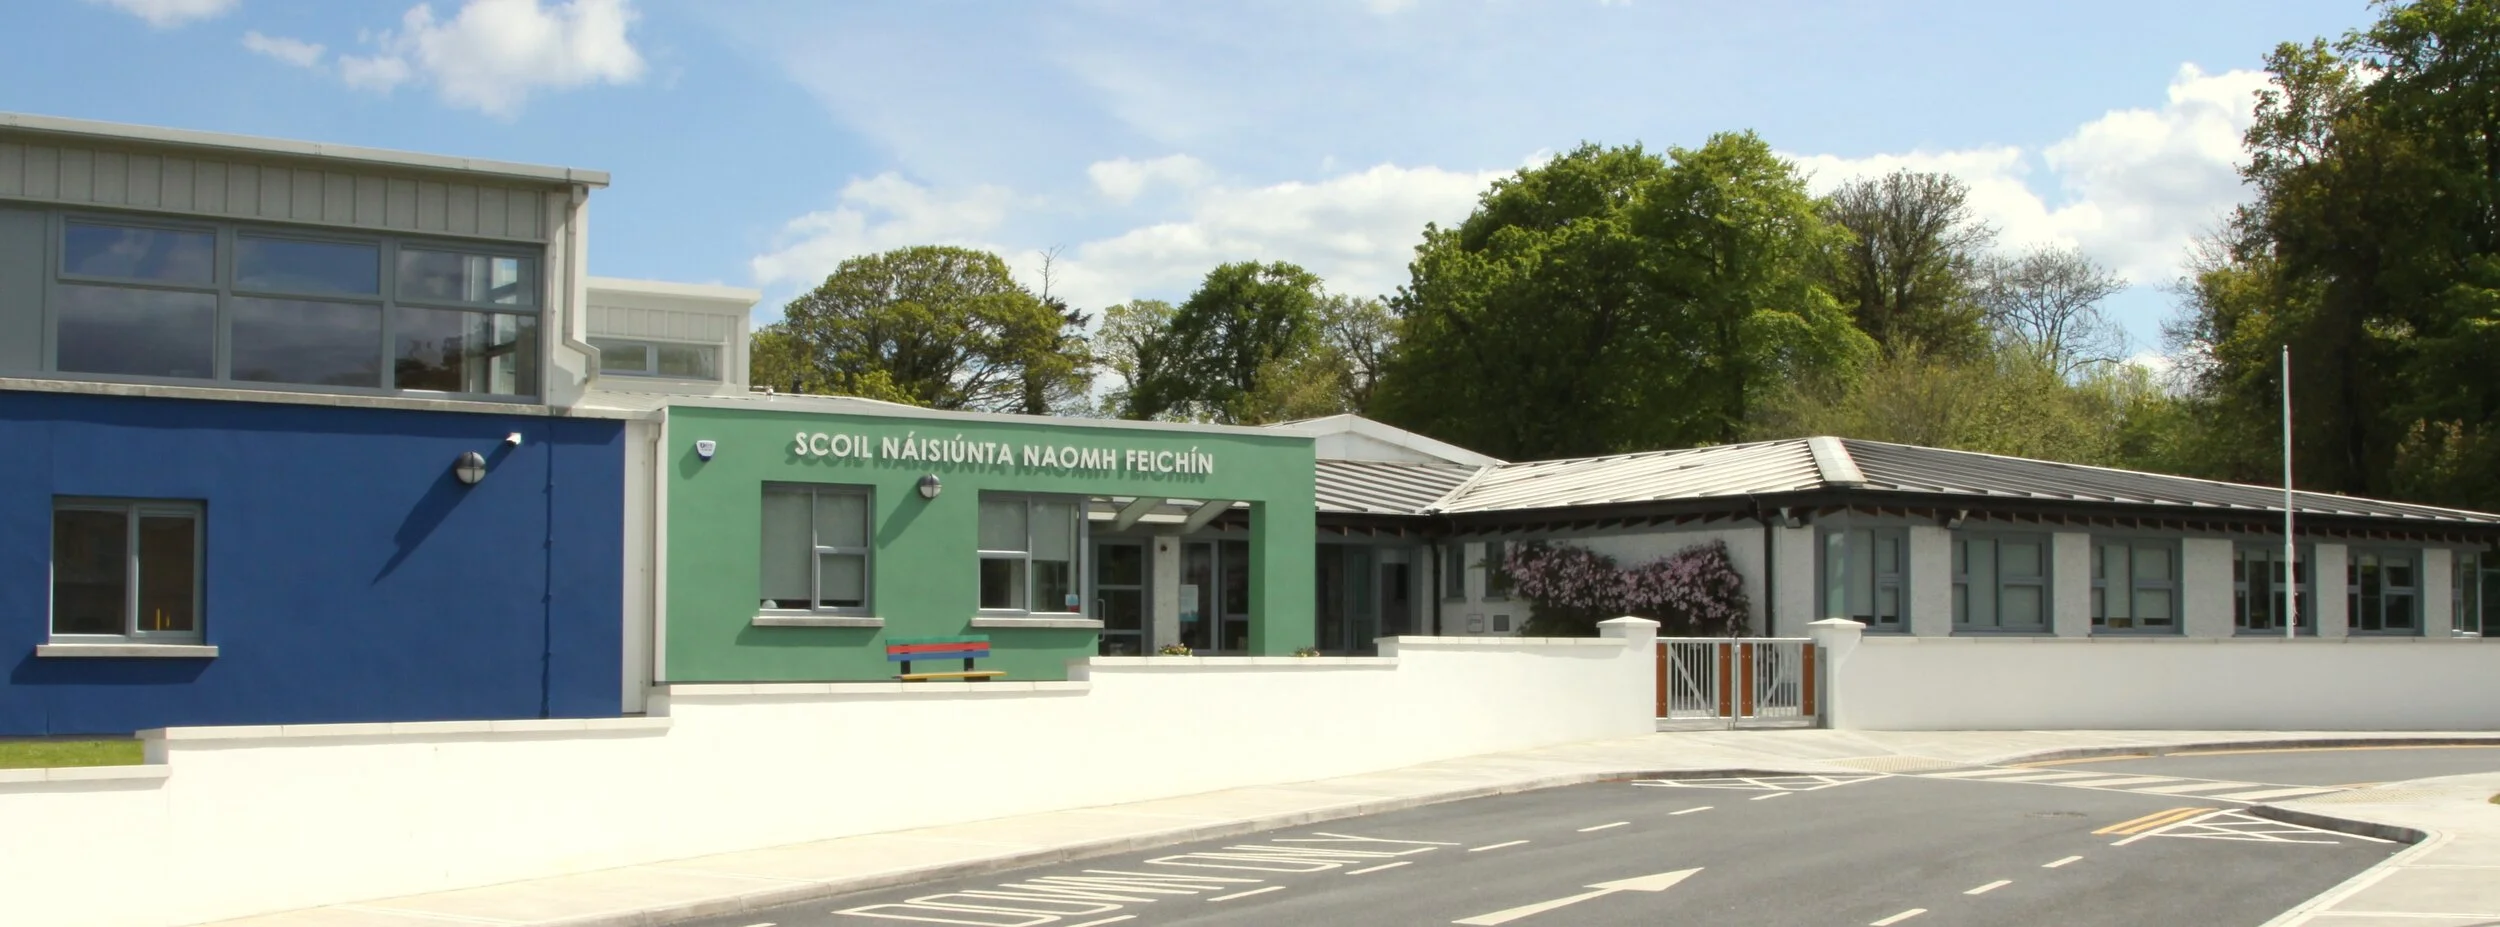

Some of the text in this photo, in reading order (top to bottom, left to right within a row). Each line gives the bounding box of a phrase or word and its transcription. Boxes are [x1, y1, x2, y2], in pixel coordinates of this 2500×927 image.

[794, 431, 1214, 475] SCOIL NÁISIÚNTA NAOMH FEICHÍN
[830, 832, 1462, 927] DOWN ONLY
